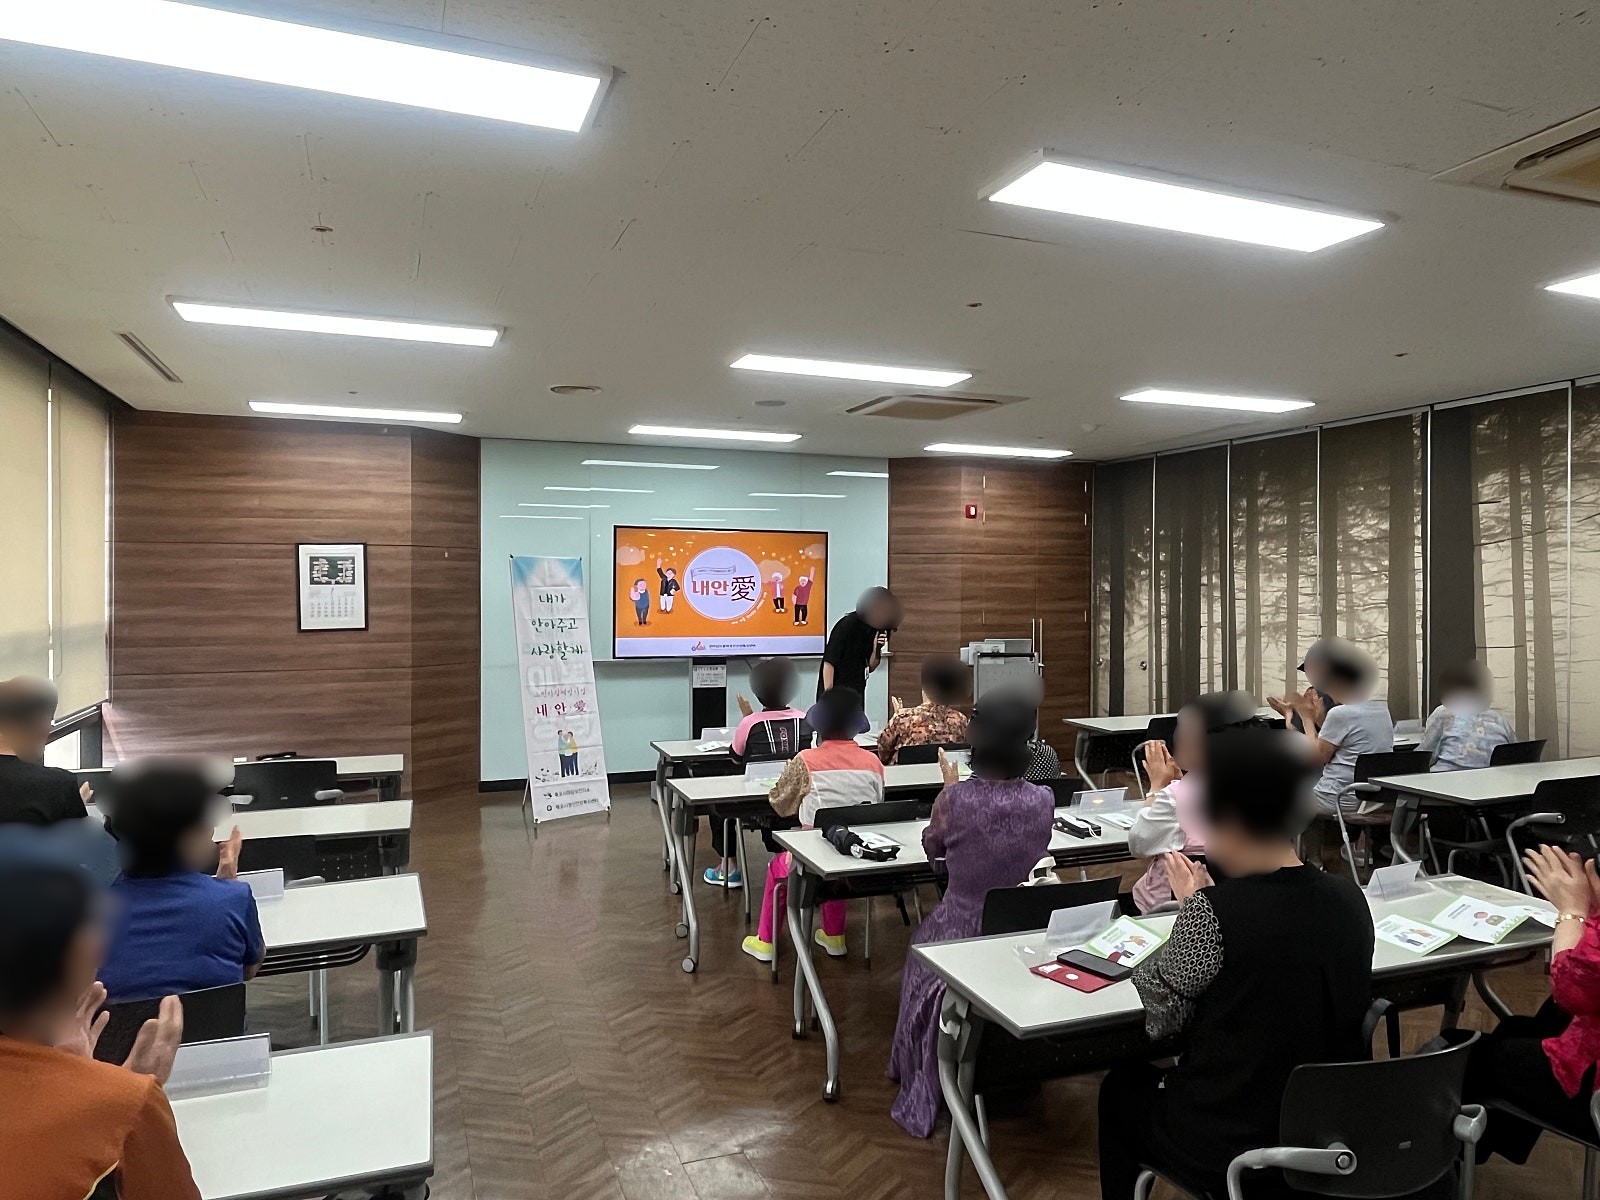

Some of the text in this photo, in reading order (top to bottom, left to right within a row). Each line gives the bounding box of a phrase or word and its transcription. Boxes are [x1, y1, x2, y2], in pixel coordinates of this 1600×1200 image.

[538, 593, 567, 604] 내가
[531, 617, 579, 634] 안아주고
[531, 640, 584, 661] 사랑할게
